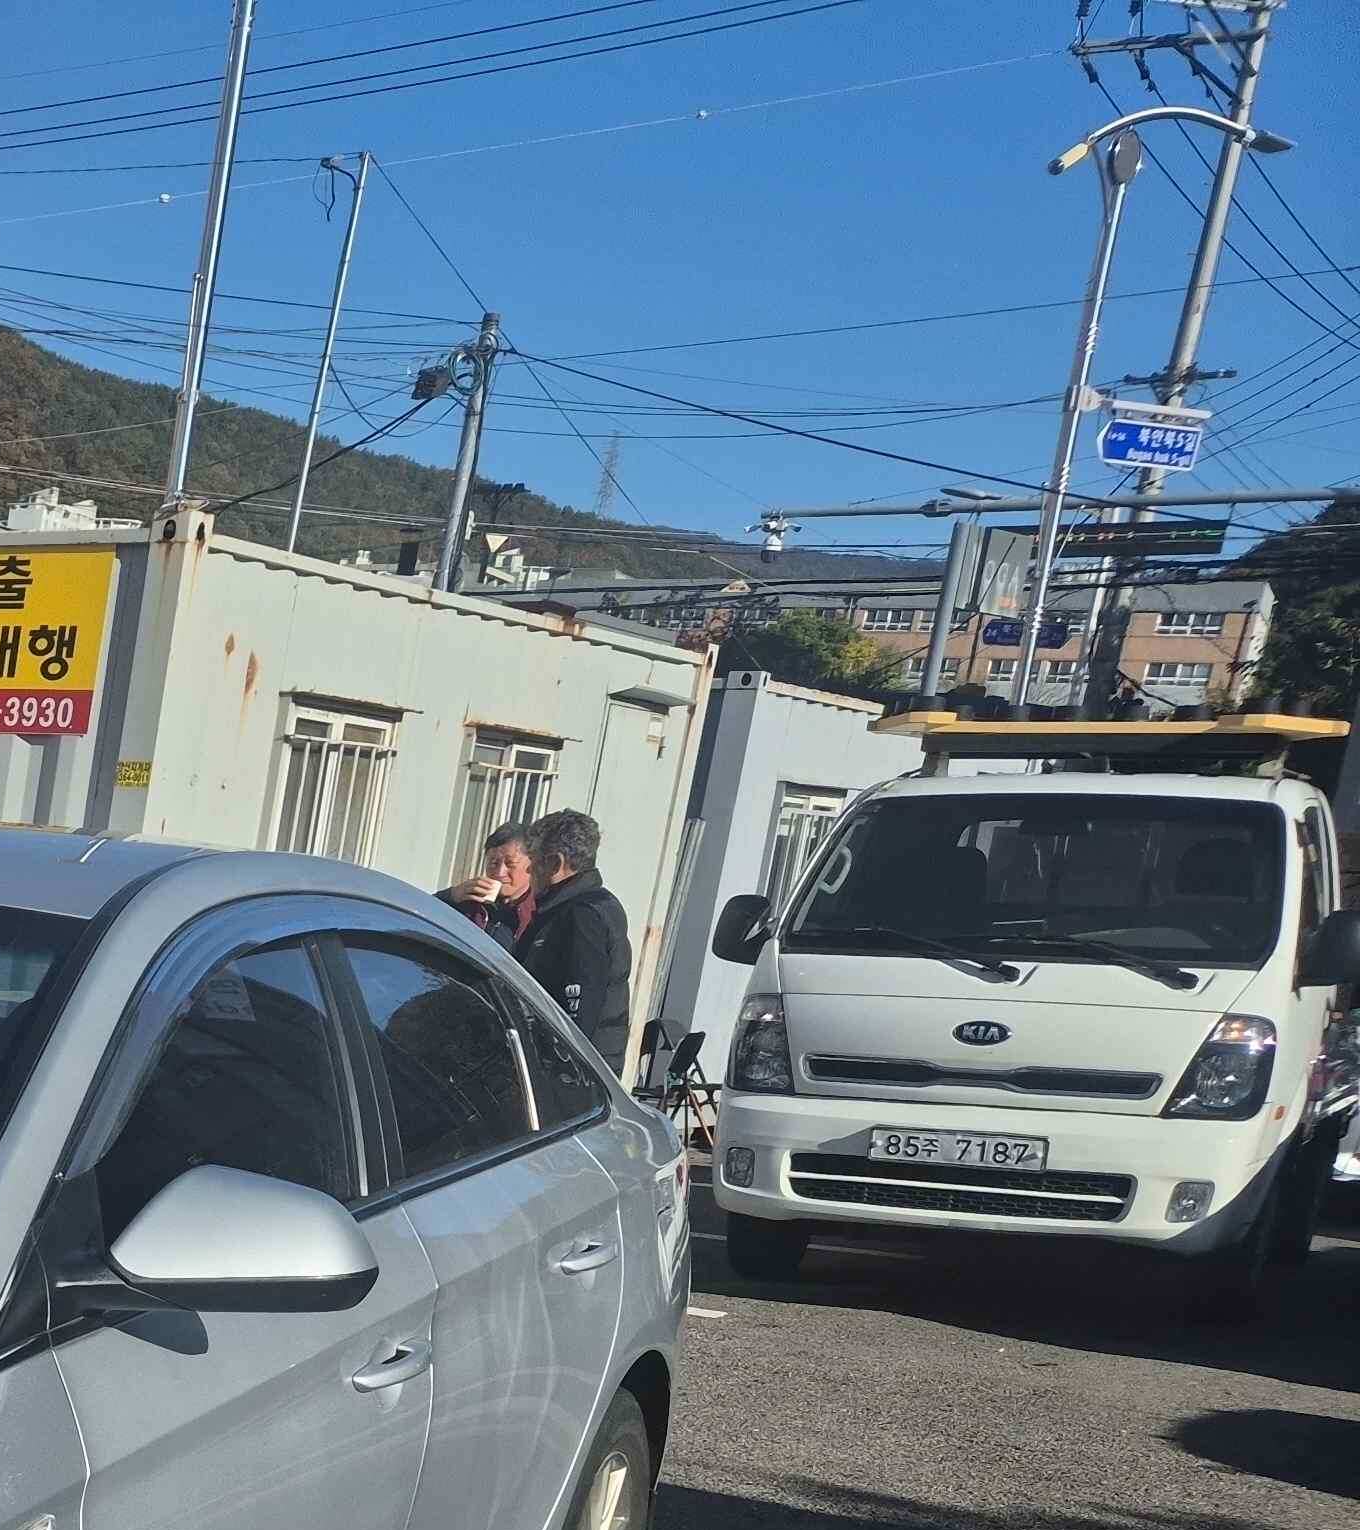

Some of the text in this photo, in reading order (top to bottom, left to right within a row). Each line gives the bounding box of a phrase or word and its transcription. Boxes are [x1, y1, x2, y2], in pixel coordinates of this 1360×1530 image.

[961, 1024, 1000, 1041] KIA
[885, 1134, 1030, 1165] 85주 7187
